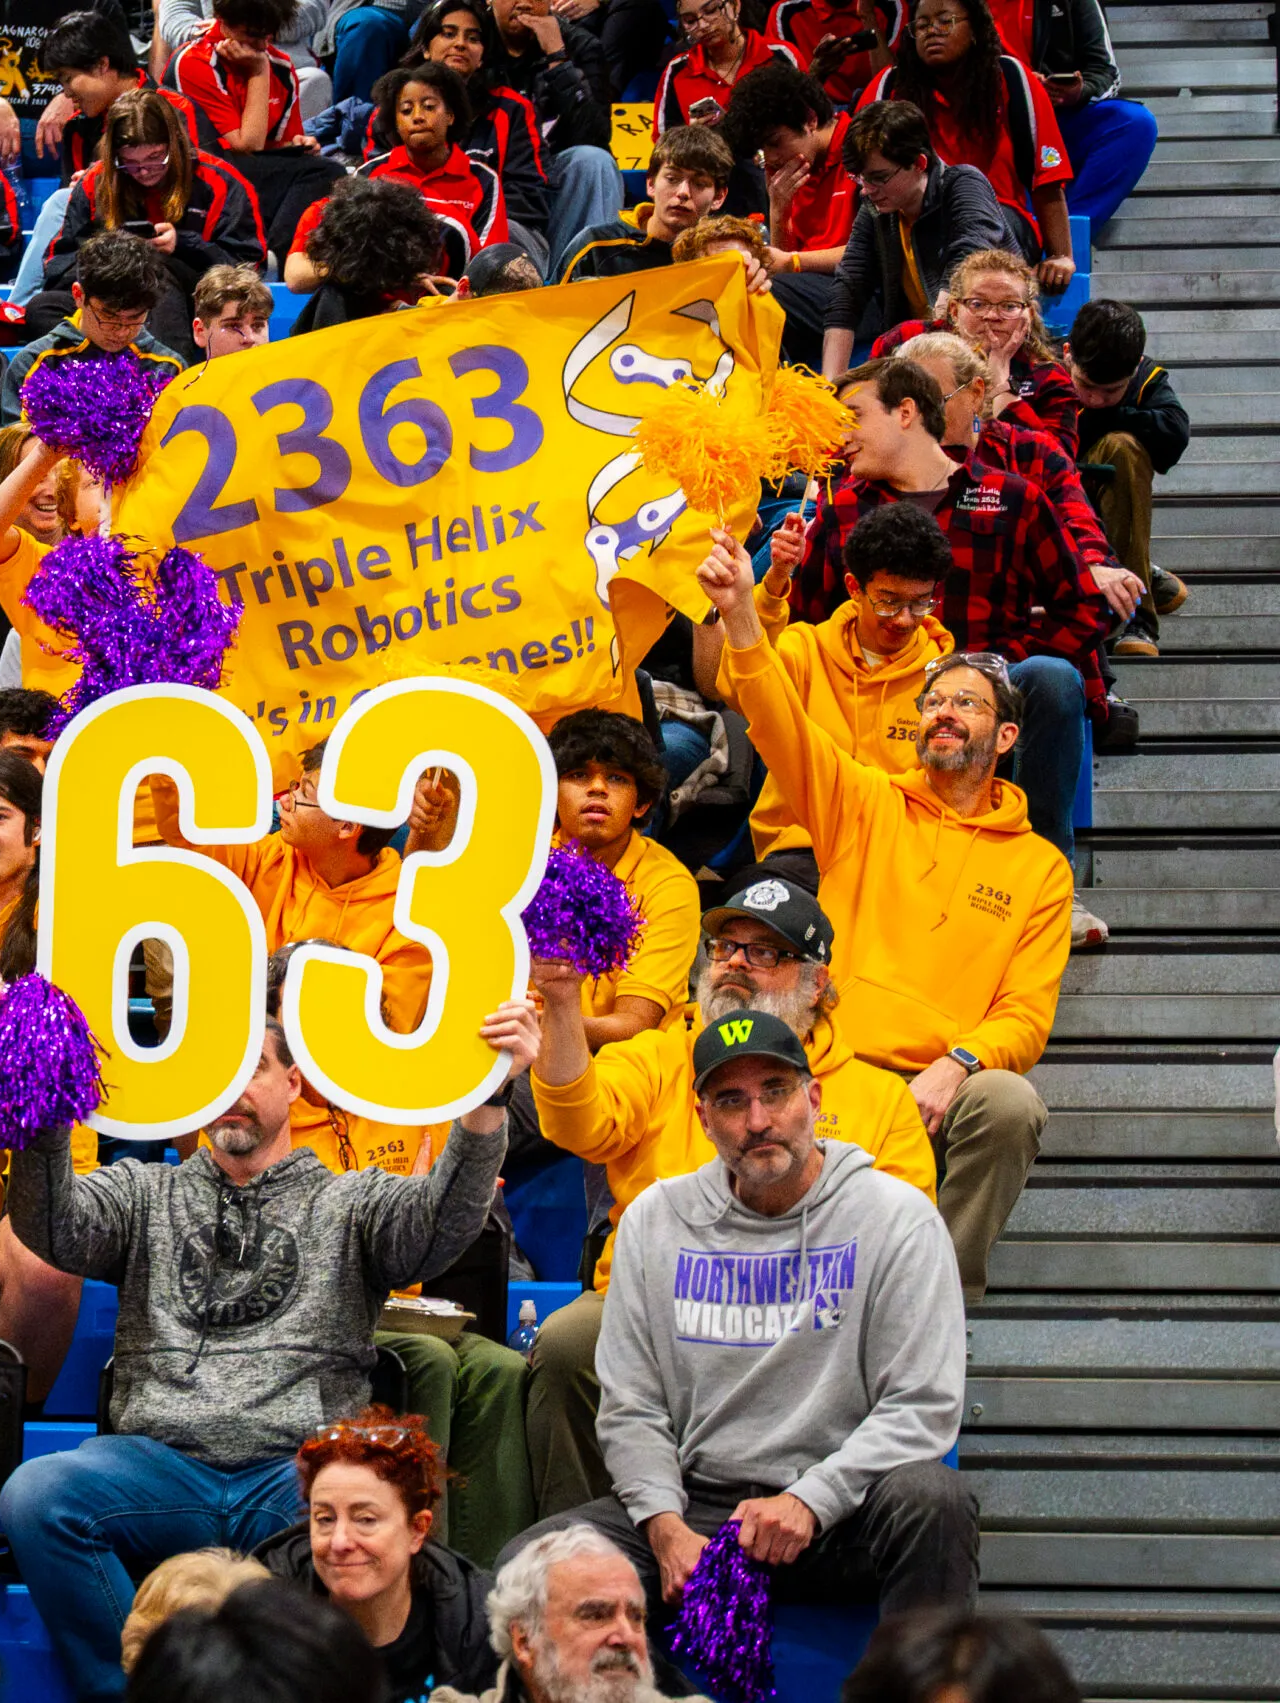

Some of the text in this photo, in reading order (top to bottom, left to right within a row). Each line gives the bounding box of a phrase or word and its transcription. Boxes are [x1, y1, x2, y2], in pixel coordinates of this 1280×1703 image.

[160, 343, 545, 544] 2363
[219, 500, 547, 608] Triple Helix
[276, 574, 522, 671] Robotics
[886, 726, 918, 742] 236
[896, 718, 919, 728] Gabri
[975, 883, 1012, 906] 2363
[718, 1018, 755, 1048] W
[366, 1139, 405, 1162] 2363
[674, 1299, 810, 1341] WILDCAT
